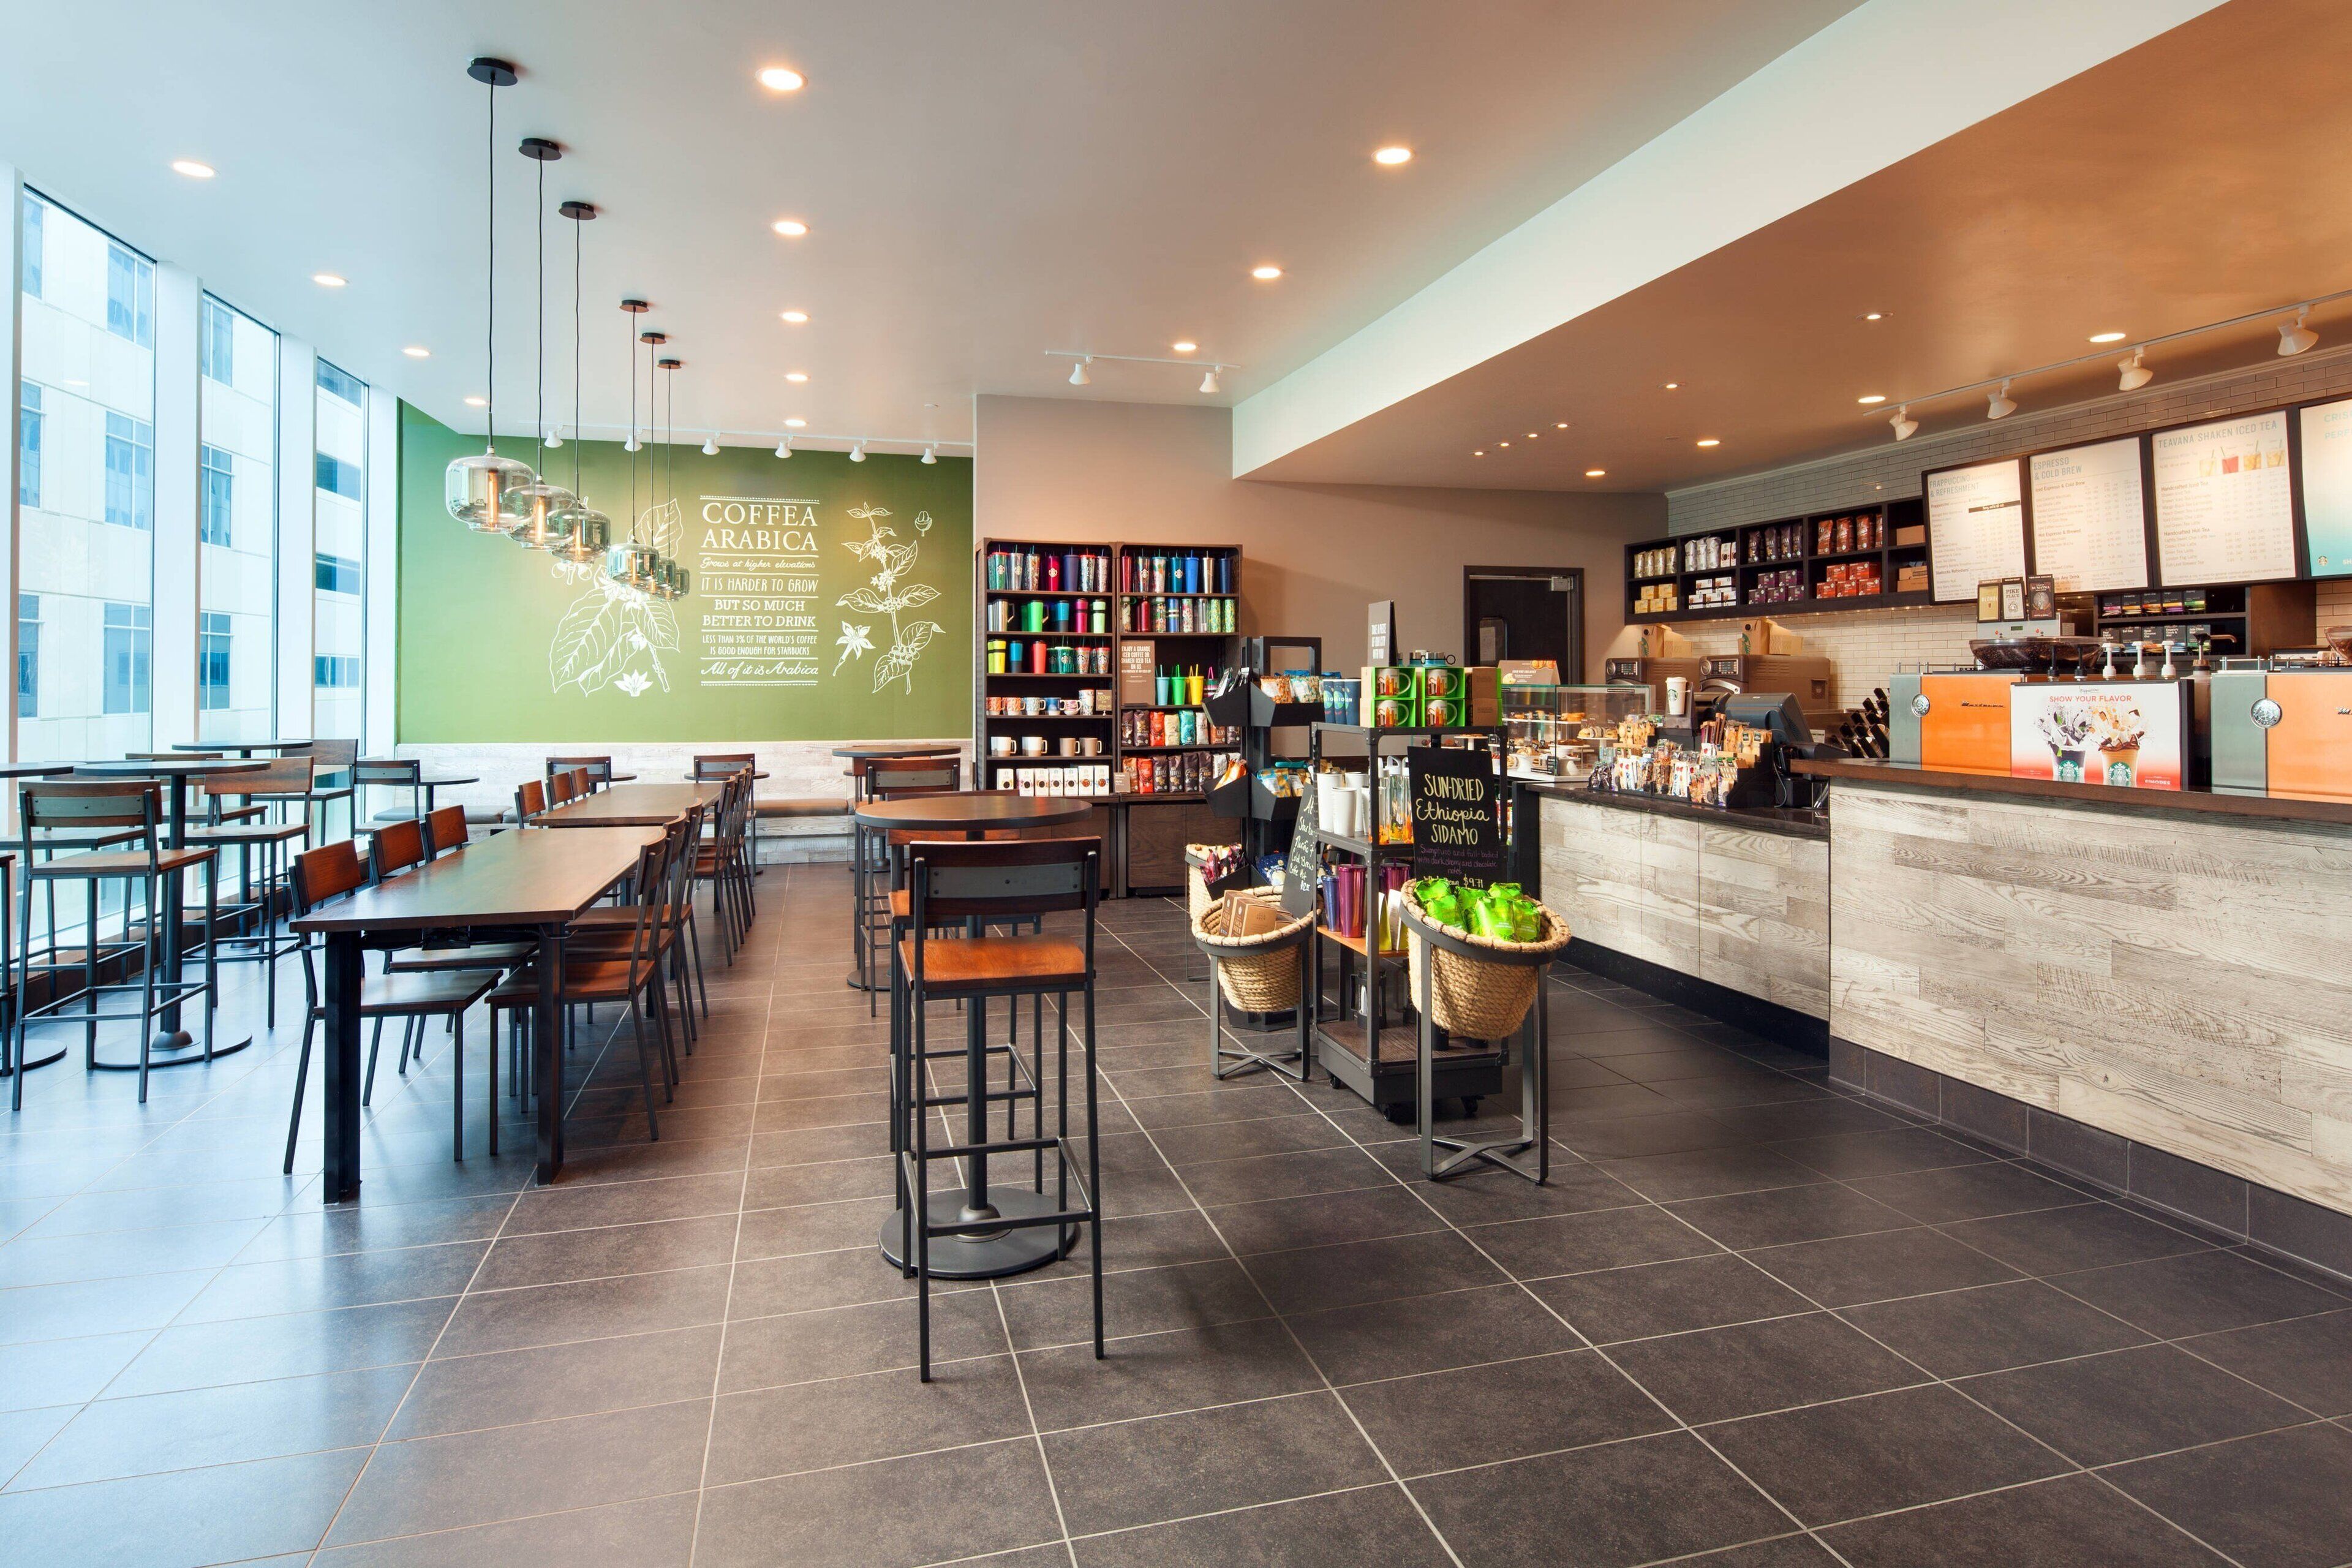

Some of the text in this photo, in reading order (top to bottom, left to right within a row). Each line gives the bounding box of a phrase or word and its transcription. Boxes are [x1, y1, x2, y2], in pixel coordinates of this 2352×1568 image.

[2158, 420, 2278, 449] TEAVANA SHAKEN ICED TEA
[2034, 457, 2070, 470] ESPRESSO
[2041, 468, 2059, 479] COLD
[2062, 465, 2082, 476] BREW
[1929, 474, 1970, 489] FRAPPUCCINO
[1936, 483, 1979, 496] REFRESHMENT
[702, 502, 818, 527] COFFEA
[701, 529, 819, 551] ARABICA
[700, 557, 815, 571] Grows at higher elevations
[701, 578, 819, 593] IT IS HARDER TO GROW
[714, 599, 805, 612] BUT SO MUCH
[702, 615, 816, 627] BETTER TO DRINK
[703, 635, 818, 644] LESS THAN 3% OF THE WORLD'S COFFEE
[777, 647, 810, 655] STARBUCKS
[701, 662, 819, 679] All of it is Arabica
[1424, 773, 1484, 802] SUN-DRIED
[1303, 795, 1314, 815] At
[1415, 798, 1490, 830] Ethiopia
[1431, 824, 1478, 845] SIDAMO
[1291, 847, 1314, 871] Cold Brew
[1463, 873, 1483, 888] $9.71
